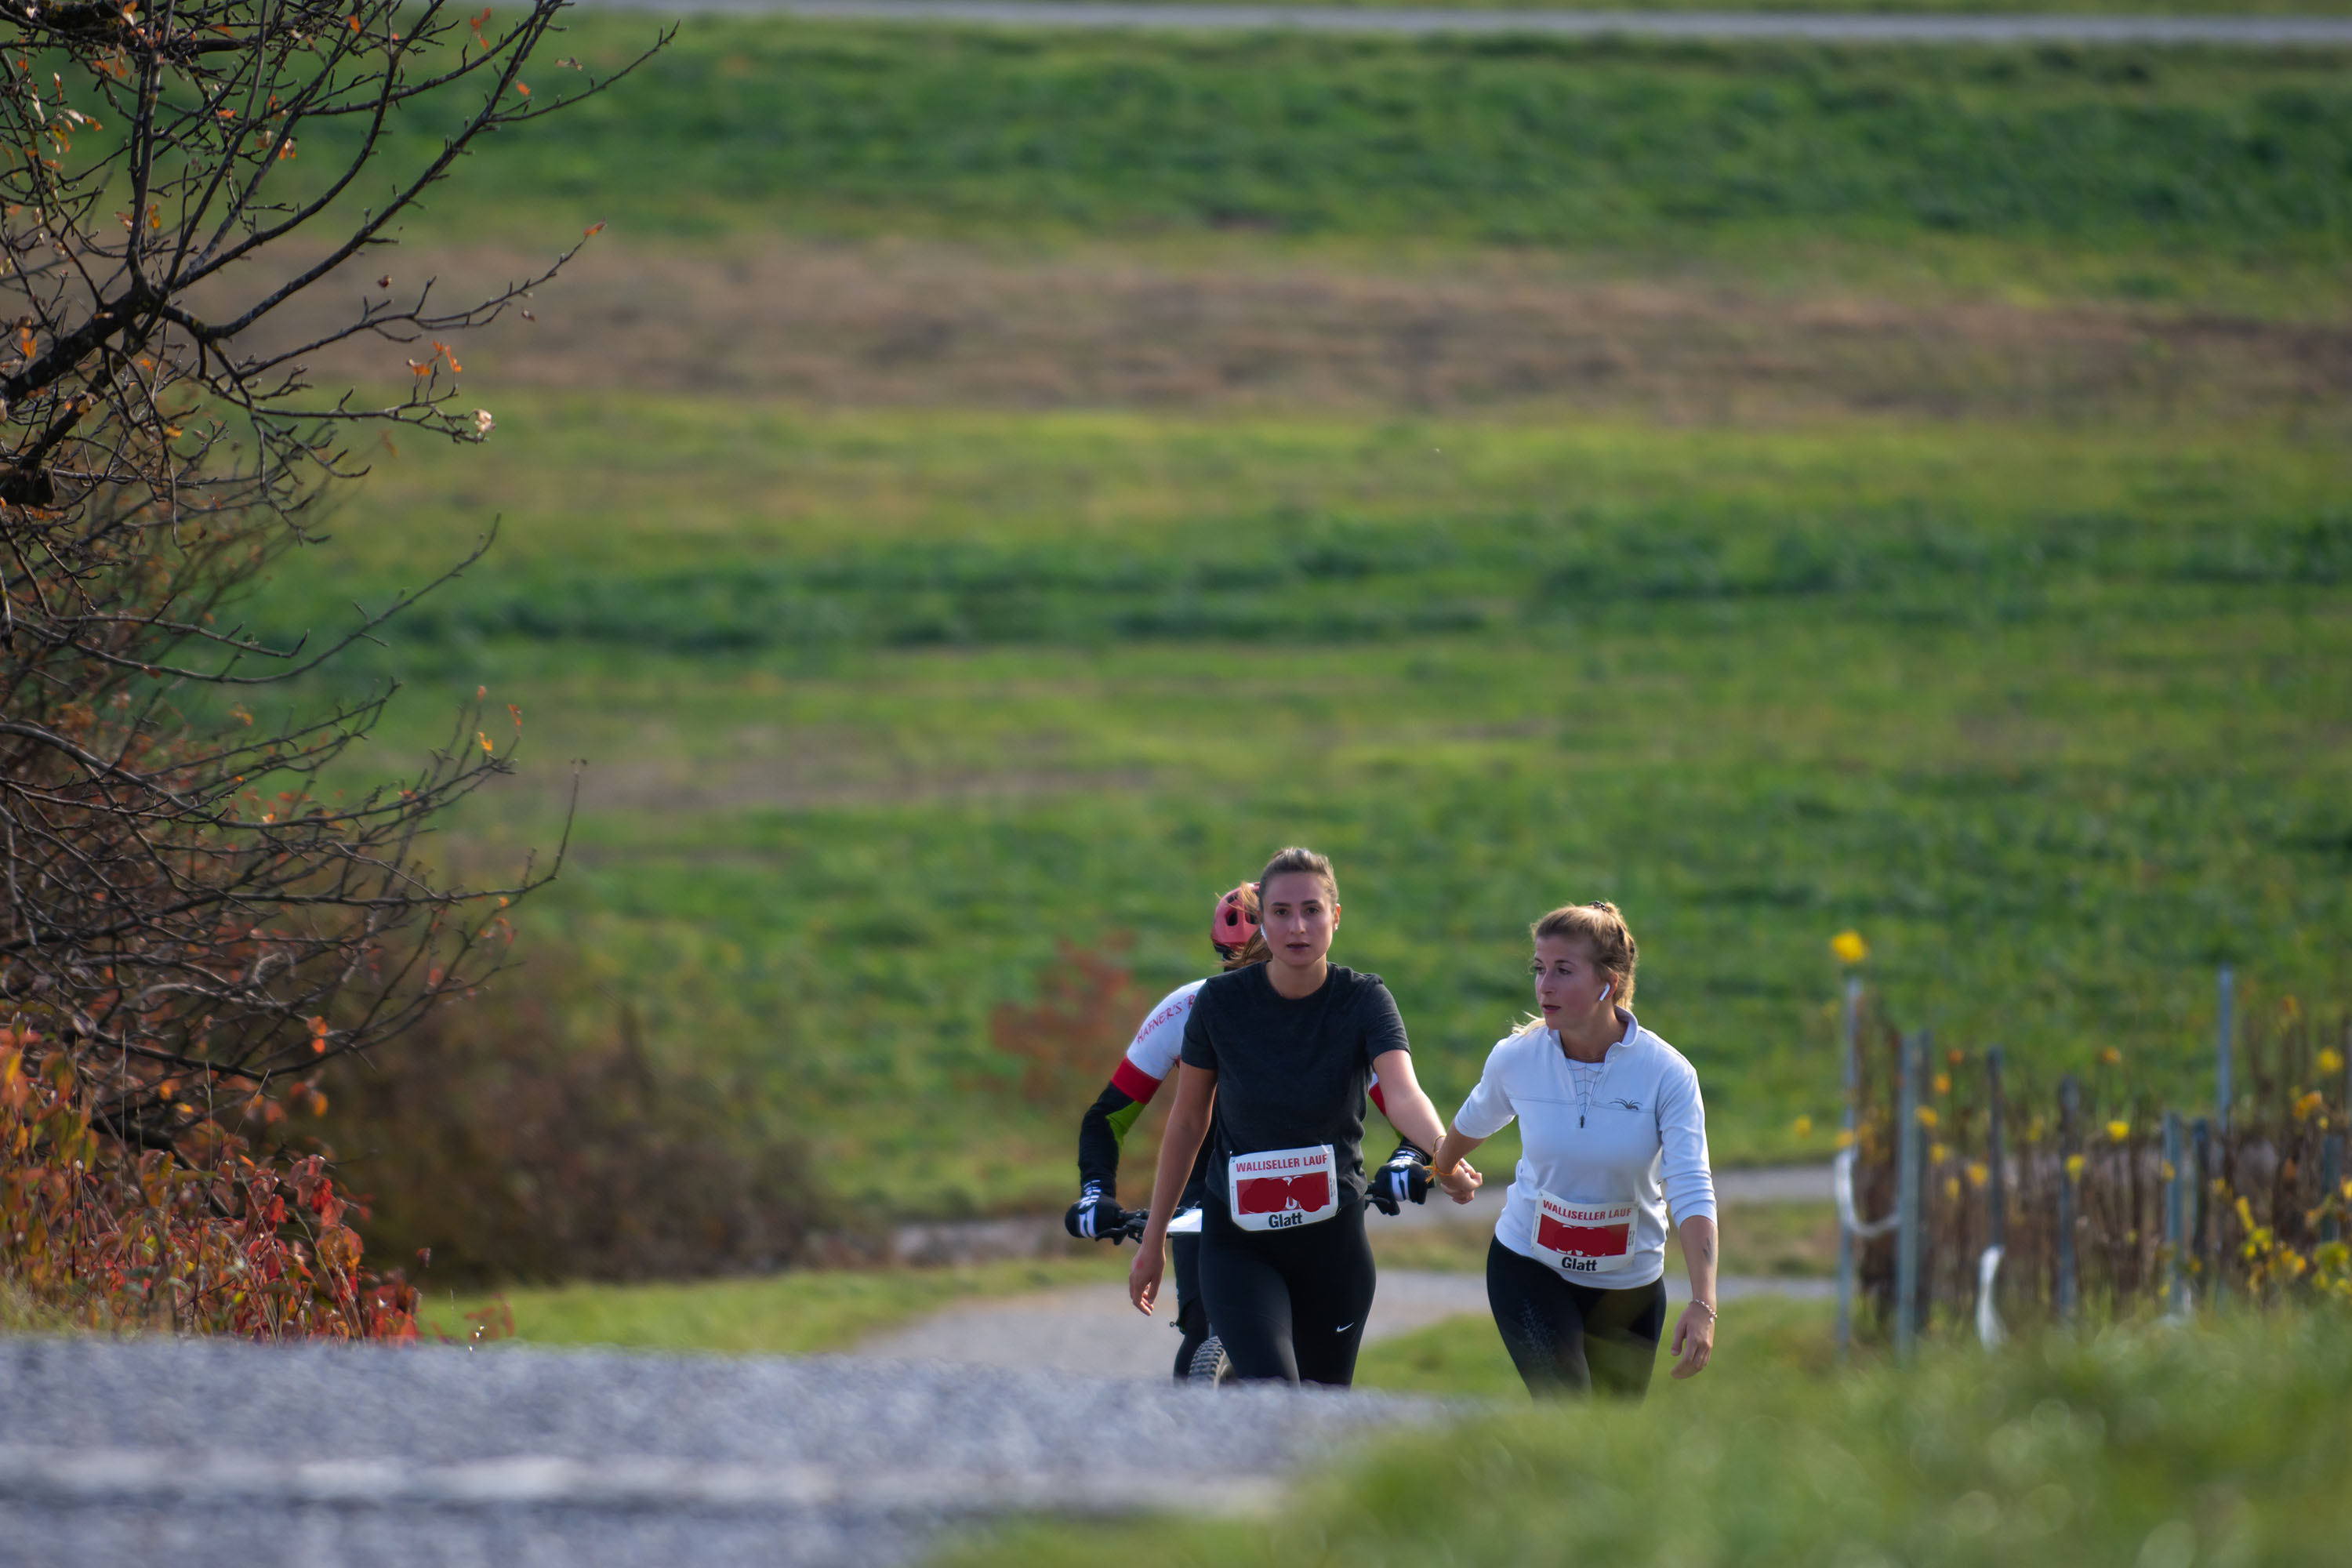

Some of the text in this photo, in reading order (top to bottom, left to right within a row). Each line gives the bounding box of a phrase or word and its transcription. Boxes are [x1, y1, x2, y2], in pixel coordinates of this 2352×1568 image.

[1136, 1001, 1183, 1044] HAFNER'S
[1236, 1154, 1327, 1173] WALLISELLER LAUF
[1543, 1199, 1632, 1221] WALLISELLER LAUF
[1269, 1212, 1302, 1228] Glatt
[1562, 1256, 1598, 1272] Glatt
